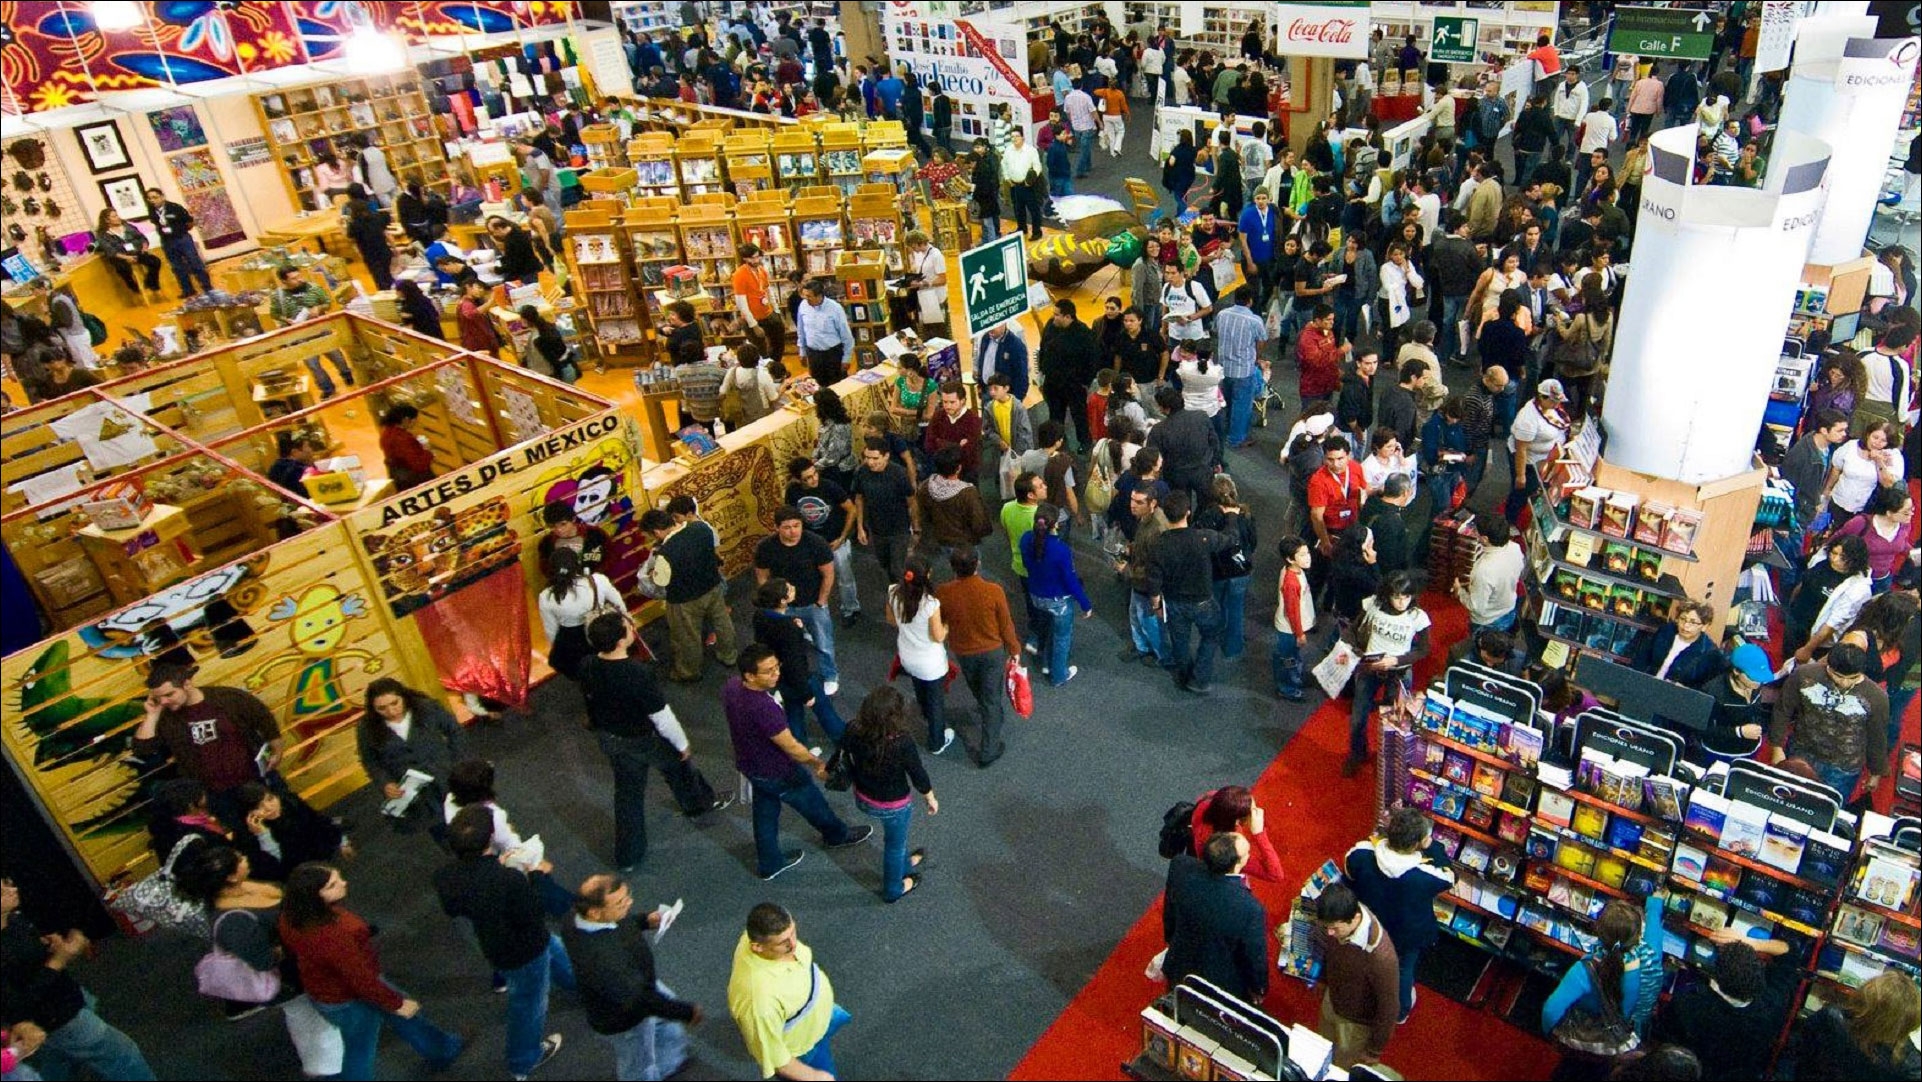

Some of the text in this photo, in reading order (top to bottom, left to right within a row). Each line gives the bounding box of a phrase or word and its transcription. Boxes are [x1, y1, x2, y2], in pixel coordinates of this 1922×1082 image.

[1640, 35, 1682, 52] Calle F
[912, 58, 969, 75] José Emilio
[983, 66, 999, 82] 70
[971, 293, 1026, 321] SALIDA DE EMERGENCIA
[980, 304, 1019, 327] EMERGENCY EXIT
[379, 473, 473, 529] ARTES
[478, 456, 515, 485] DE
[711, 502, 745, 526] RTES
[1461, 683, 1517, 707] EDICIONES URANO
[1592, 731, 1656, 756] EDICIONES URANO
[1744, 786, 1816, 817] EDICIONES URANO
